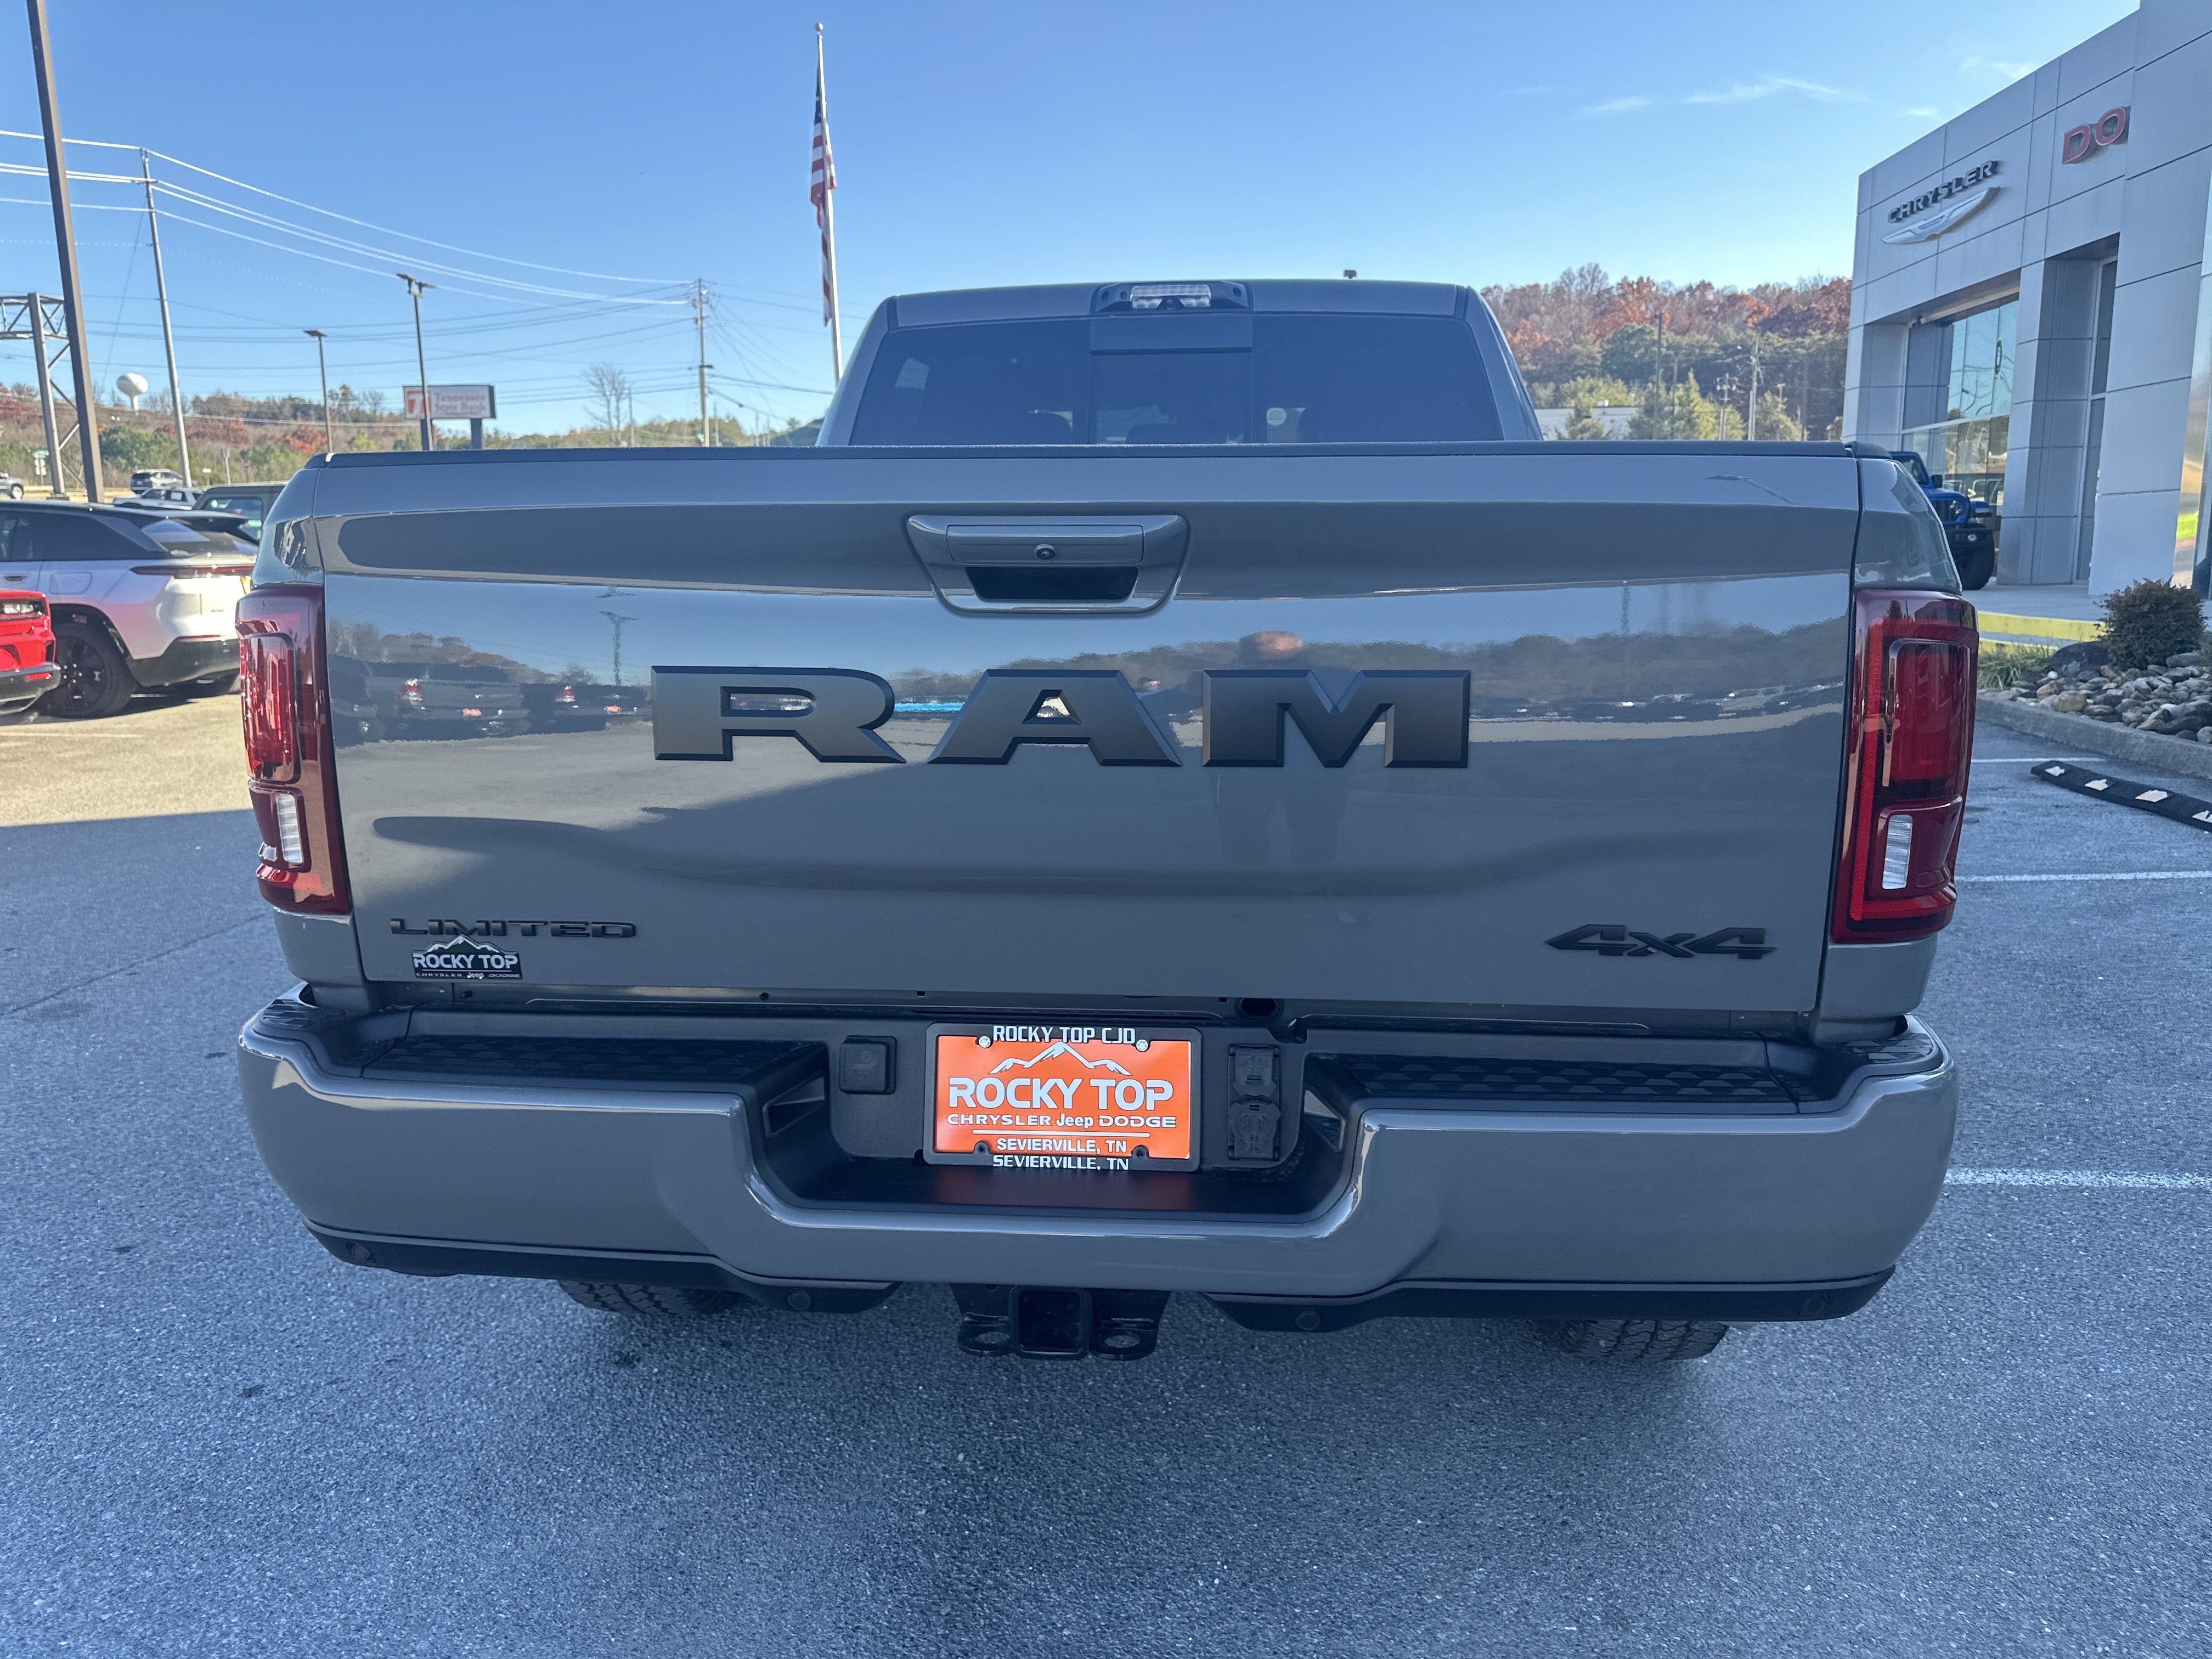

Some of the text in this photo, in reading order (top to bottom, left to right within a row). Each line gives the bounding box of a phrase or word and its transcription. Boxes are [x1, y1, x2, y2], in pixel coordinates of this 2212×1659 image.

[1887, 160, 2000, 223] CHRYSLER
[651, 665, 1471, 769] RAM
[390, 918, 636, 938] LIMITED
[413, 953, 518, 969] ROCKY TOP
[993, 1025, 1136, 1045] ROCKY TOP CJD
[949, 1077, 1174, 1111] ROCKY TOP
[947, 1113, 1177, 1129] CHRYSLER Jeep DODGE
[997, 1138, 1127, 1155] SEVIERVILLE, TN
[992, 1155, 1129, 1171] SEVIERVILLE, TN
